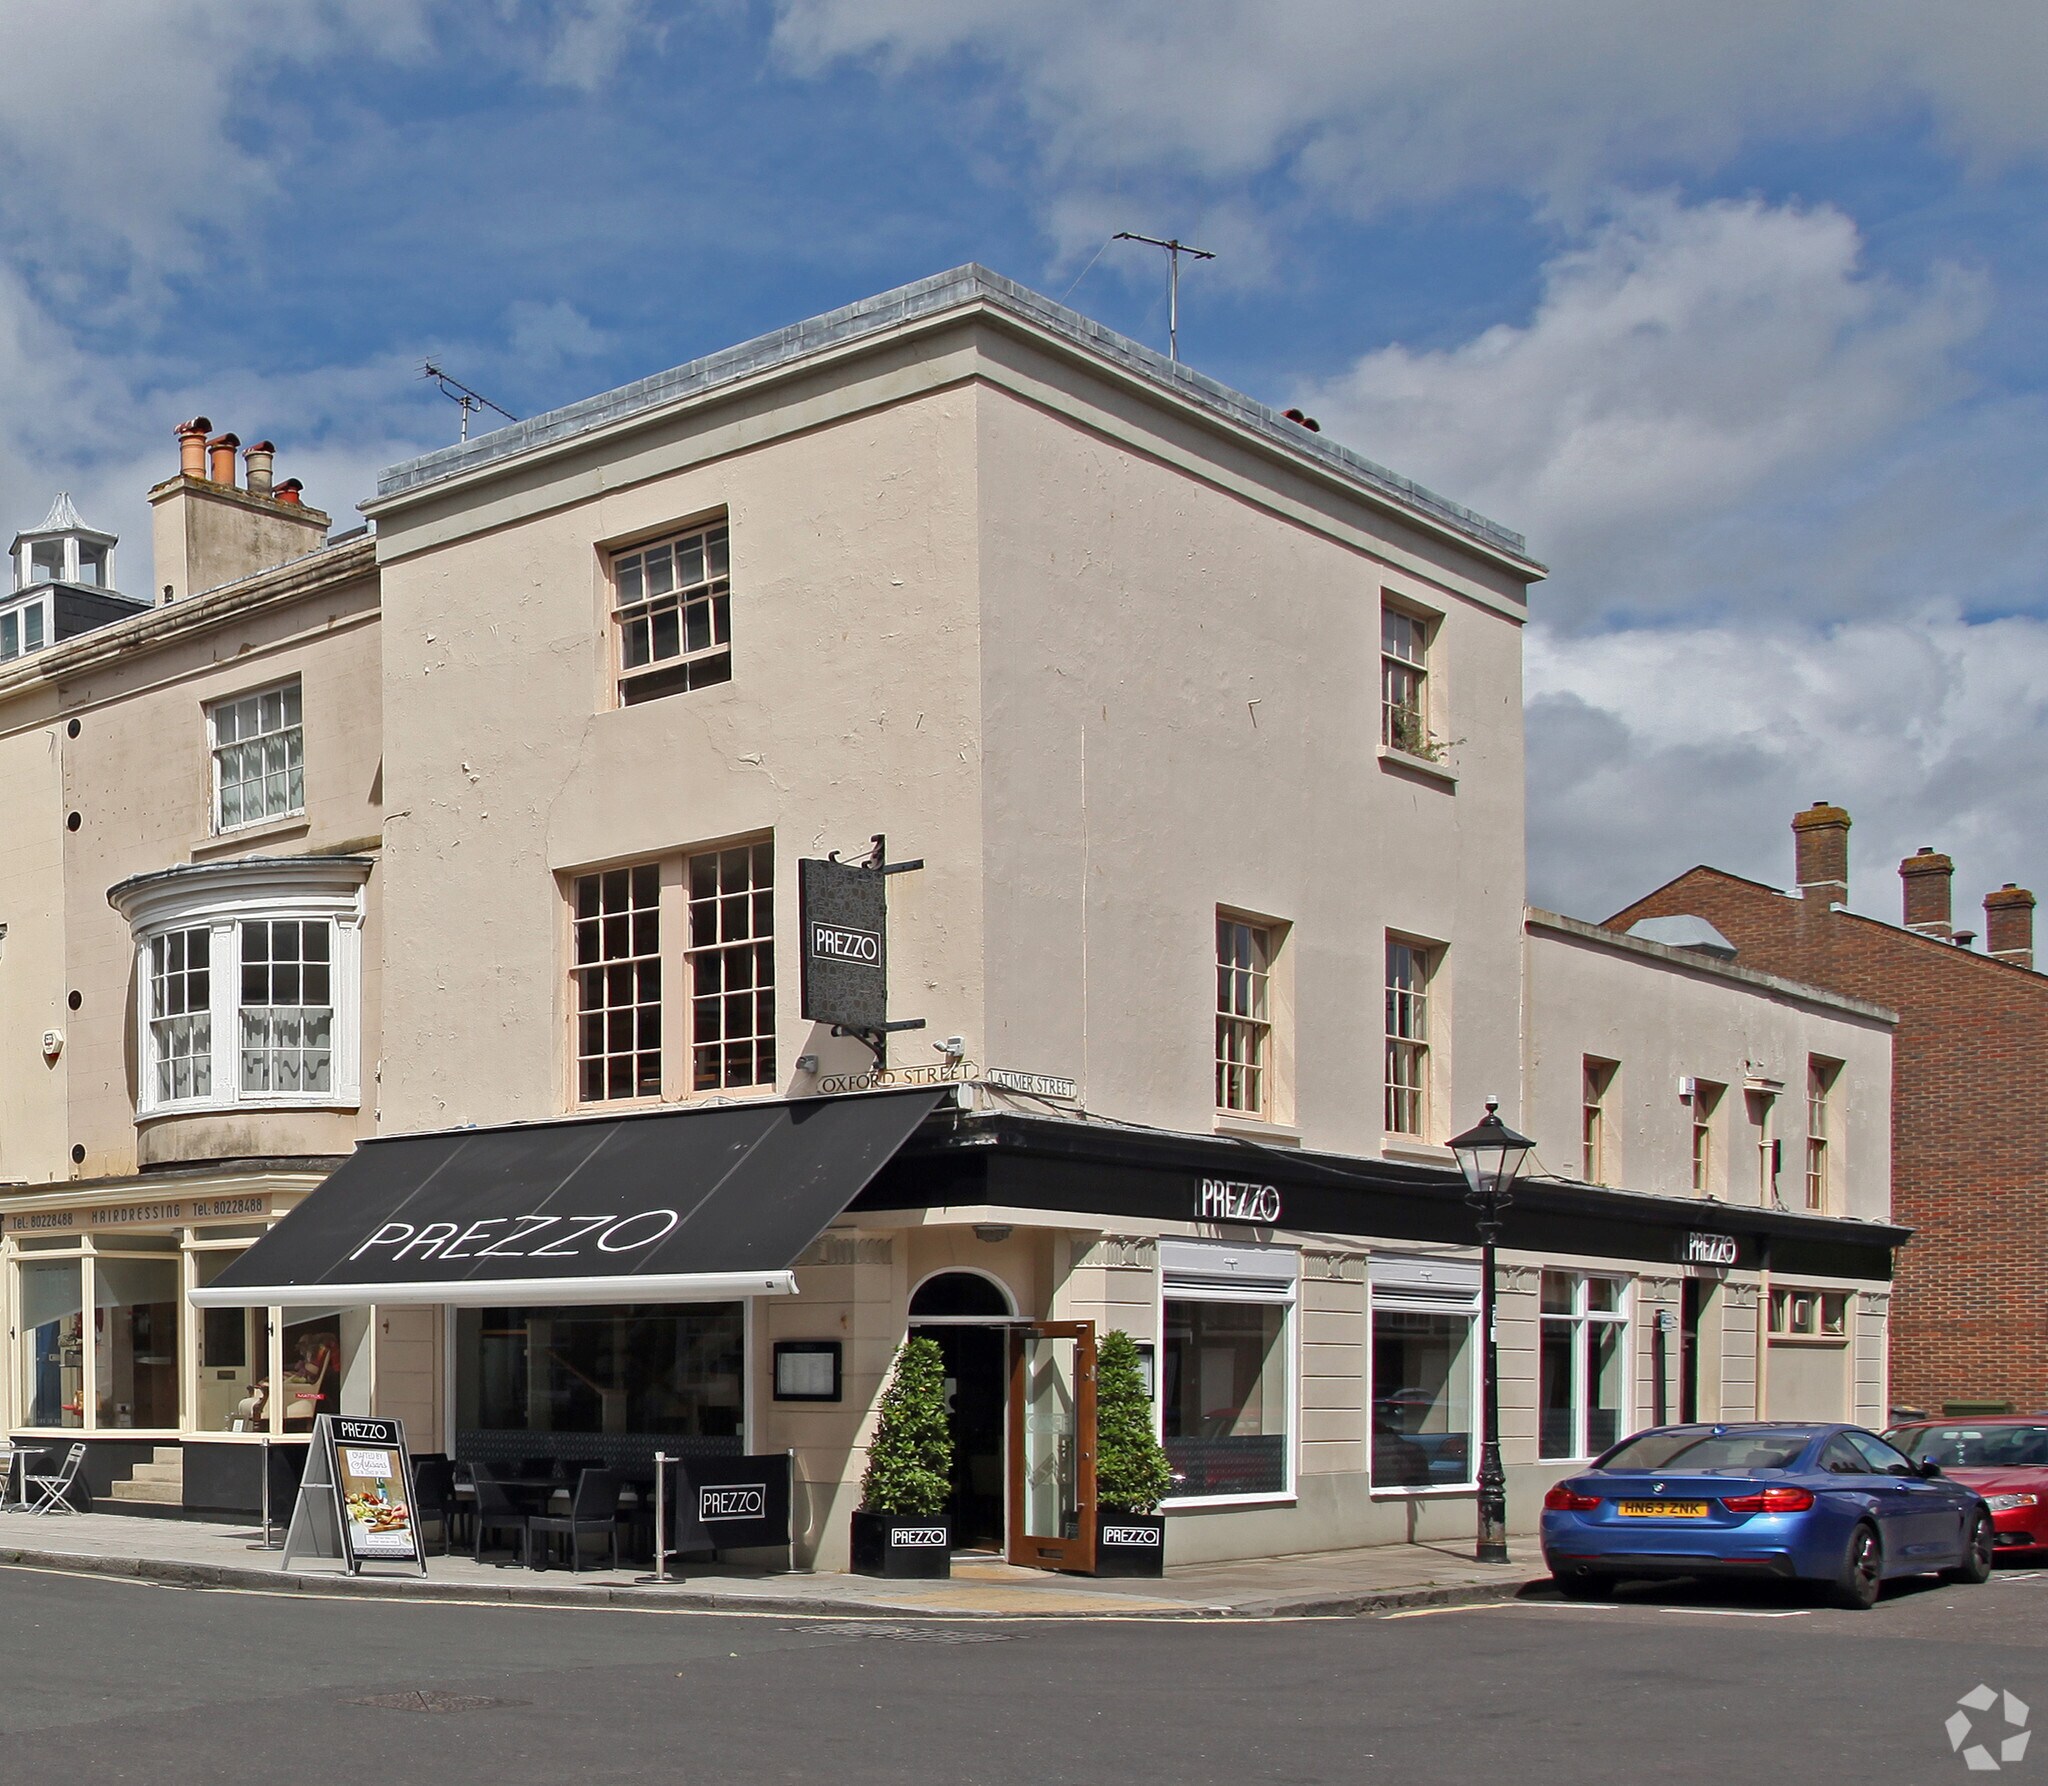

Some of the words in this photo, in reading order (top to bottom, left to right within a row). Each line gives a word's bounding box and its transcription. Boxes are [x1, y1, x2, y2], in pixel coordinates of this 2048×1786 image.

[816, 928, 877, 960] PREZZO
[822, 1072, 895, 1093] OXFORD
[903, 1063, 972, 1084] STREET
[1037, 1077, 1075, 1097] STREET
[192, 1202, 211, 1217] Tel:
[213, 1198, 262, 1215] 80228488
[1202, 1178, 1280, 1223] PREZZO
[12, 1216, 28, 1230] Tel:
[30, 1212, 73, 1228] 80228488
[91, 1204, 181, 1224] HAIRDRESSING
[348, 1208, 679, 1262] PREZZO
[1689, 1232, 1736, 1264] PREZZO
[341, 1421, 387, 1440] PREZZO
[703, 1491, 761, 1514] PREZZO
[1624, 1502, 1664, 1513] HN63
[1669, 1503, 1699, 1514] ZNK
[894, 1530, 944, 1544] PREZZO
[1106, 1528, 1157, 1543] PREZZO
